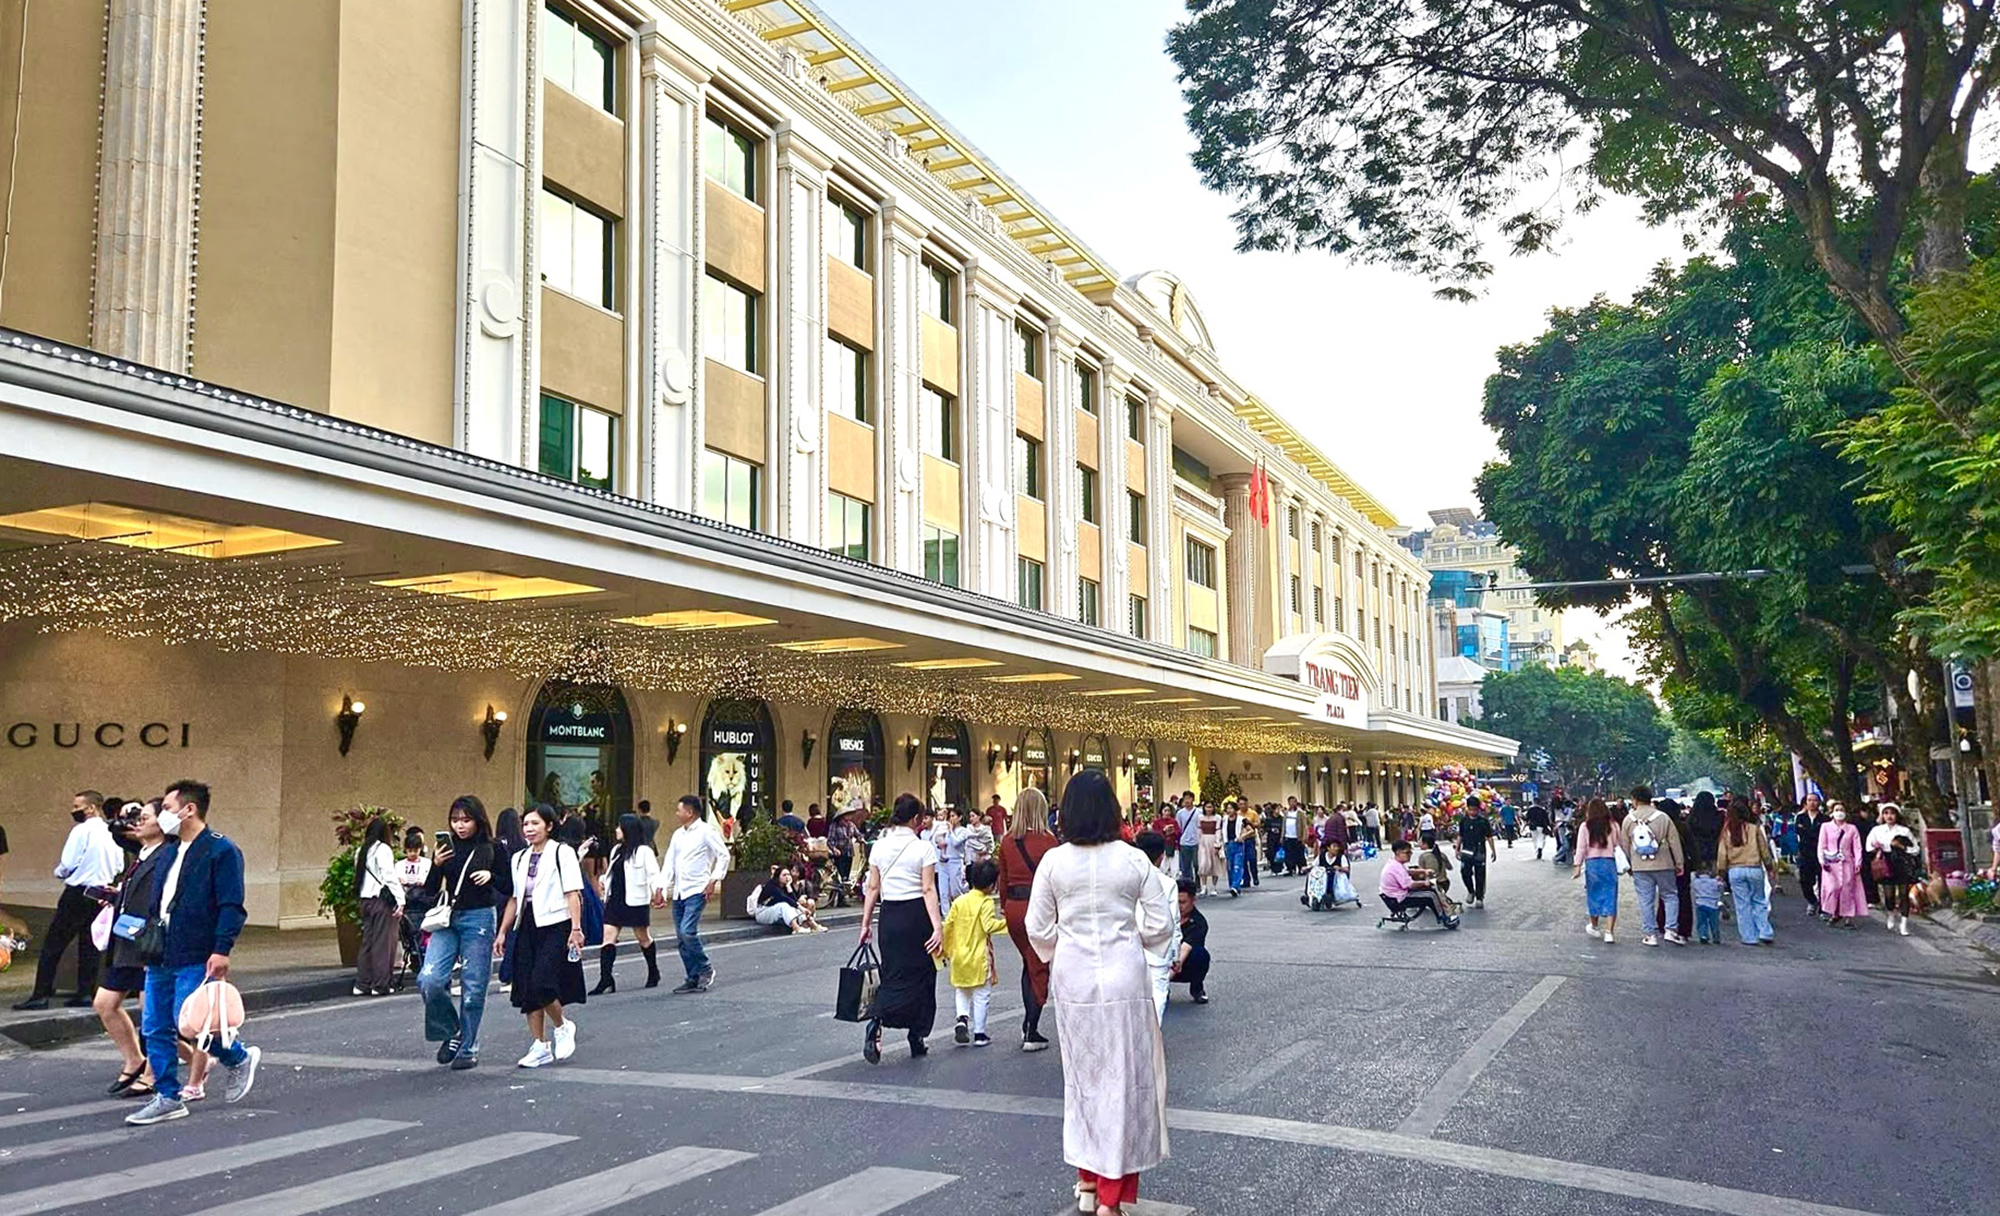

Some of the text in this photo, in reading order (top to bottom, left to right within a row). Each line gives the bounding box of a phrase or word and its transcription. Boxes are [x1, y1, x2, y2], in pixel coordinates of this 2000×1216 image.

[1305, 661, 1339, 695] TRANG
[1326, 703, 1345, 719] PLAZA
[7, 722, 190, 748] GUCCI
[549, 724, 605, 738] MONTBLANC
[713, 730, 754, 745] HUBLOT
[839, 738, 865, 752] VERSACE
[751, 753, 759, 807] HUBL
